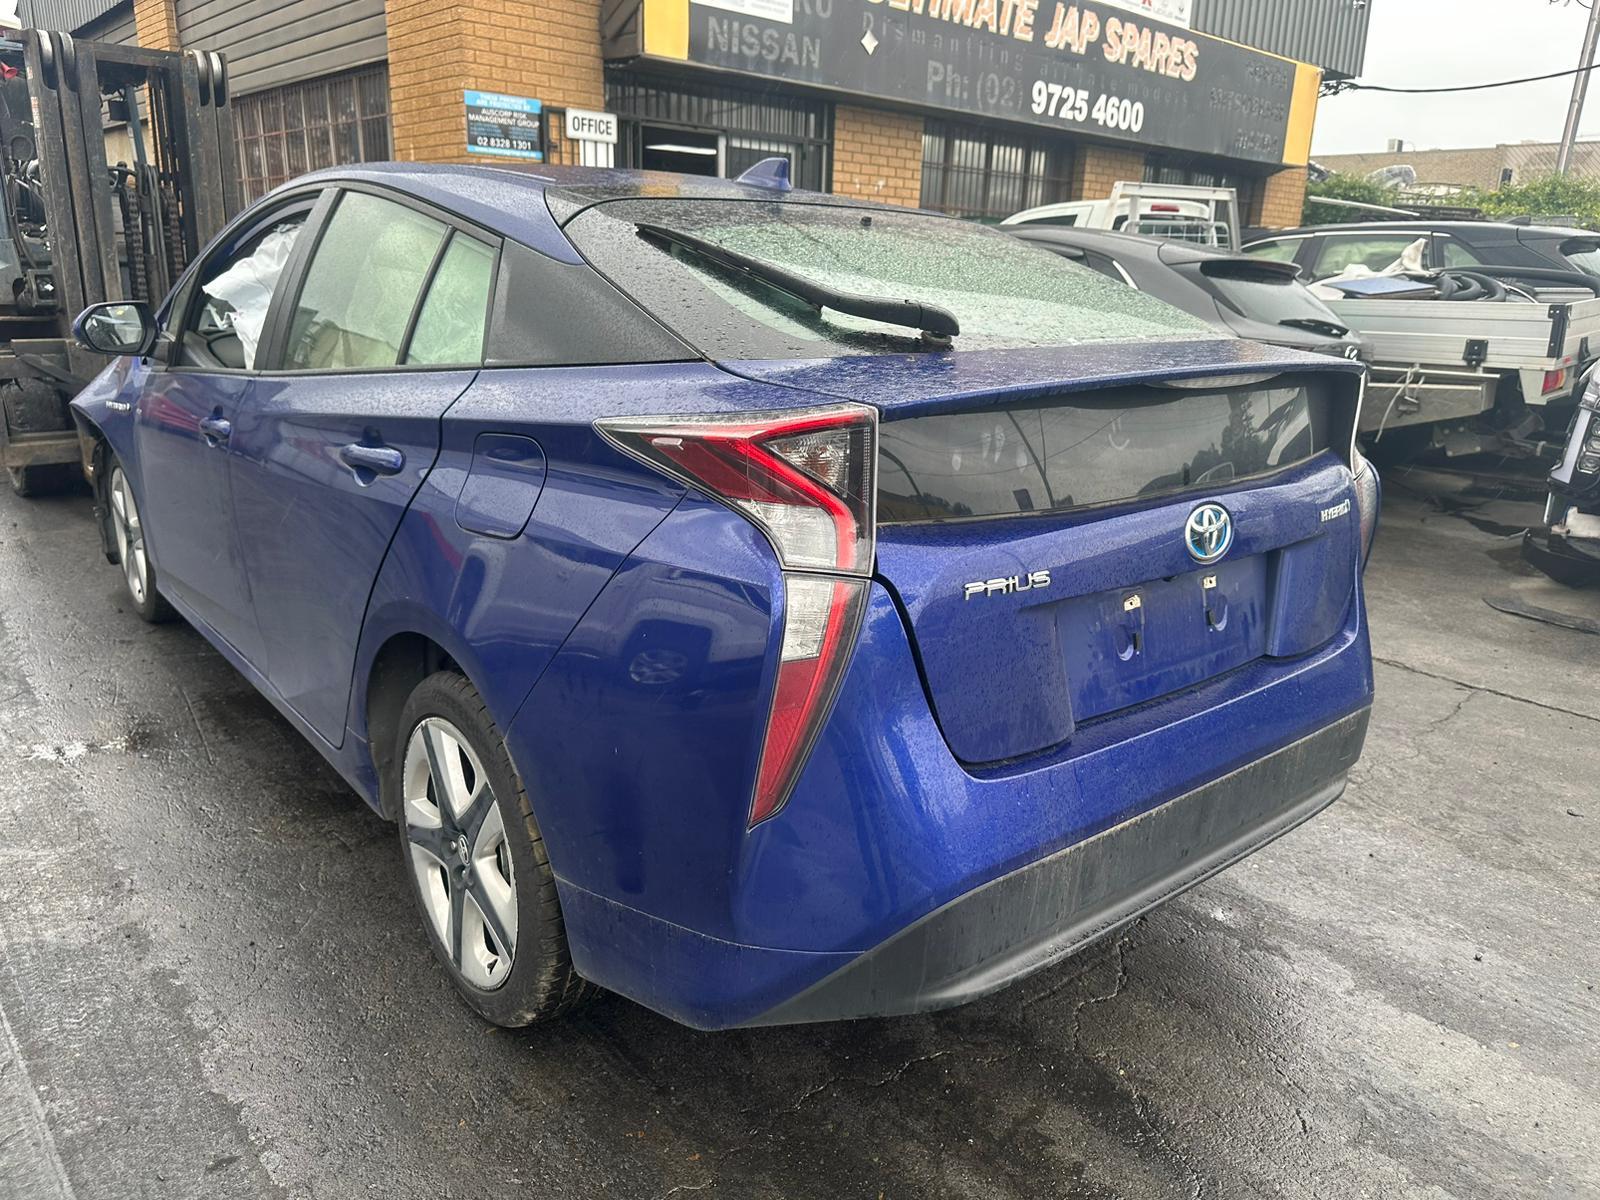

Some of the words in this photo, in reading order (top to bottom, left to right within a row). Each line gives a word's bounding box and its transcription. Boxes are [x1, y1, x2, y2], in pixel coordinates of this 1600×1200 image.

[707, 16, 821, 68] NISSAN
[865, 0, 1039, 42] MATE
[1044, 2, 1100, 55] JAP
[1102, 17, 1199, 81] SPARES
[927, 60, 968, 99] Ph:
[1031, 80, 1089, 122] 9725
[1092, 94, 1144, 132] 4600
[468, 113, 516, 126] MANAGEMENT
[517, 119, 540, 128] GROUP
[572, 116, 612, 135] OFFICE
[477, 136, 488, 146] 02
[512, 140, 531, 150] 1301
[1320, 498, 1351, 522] HYBRID
[964, 570, 1051, 600] PRIUS
